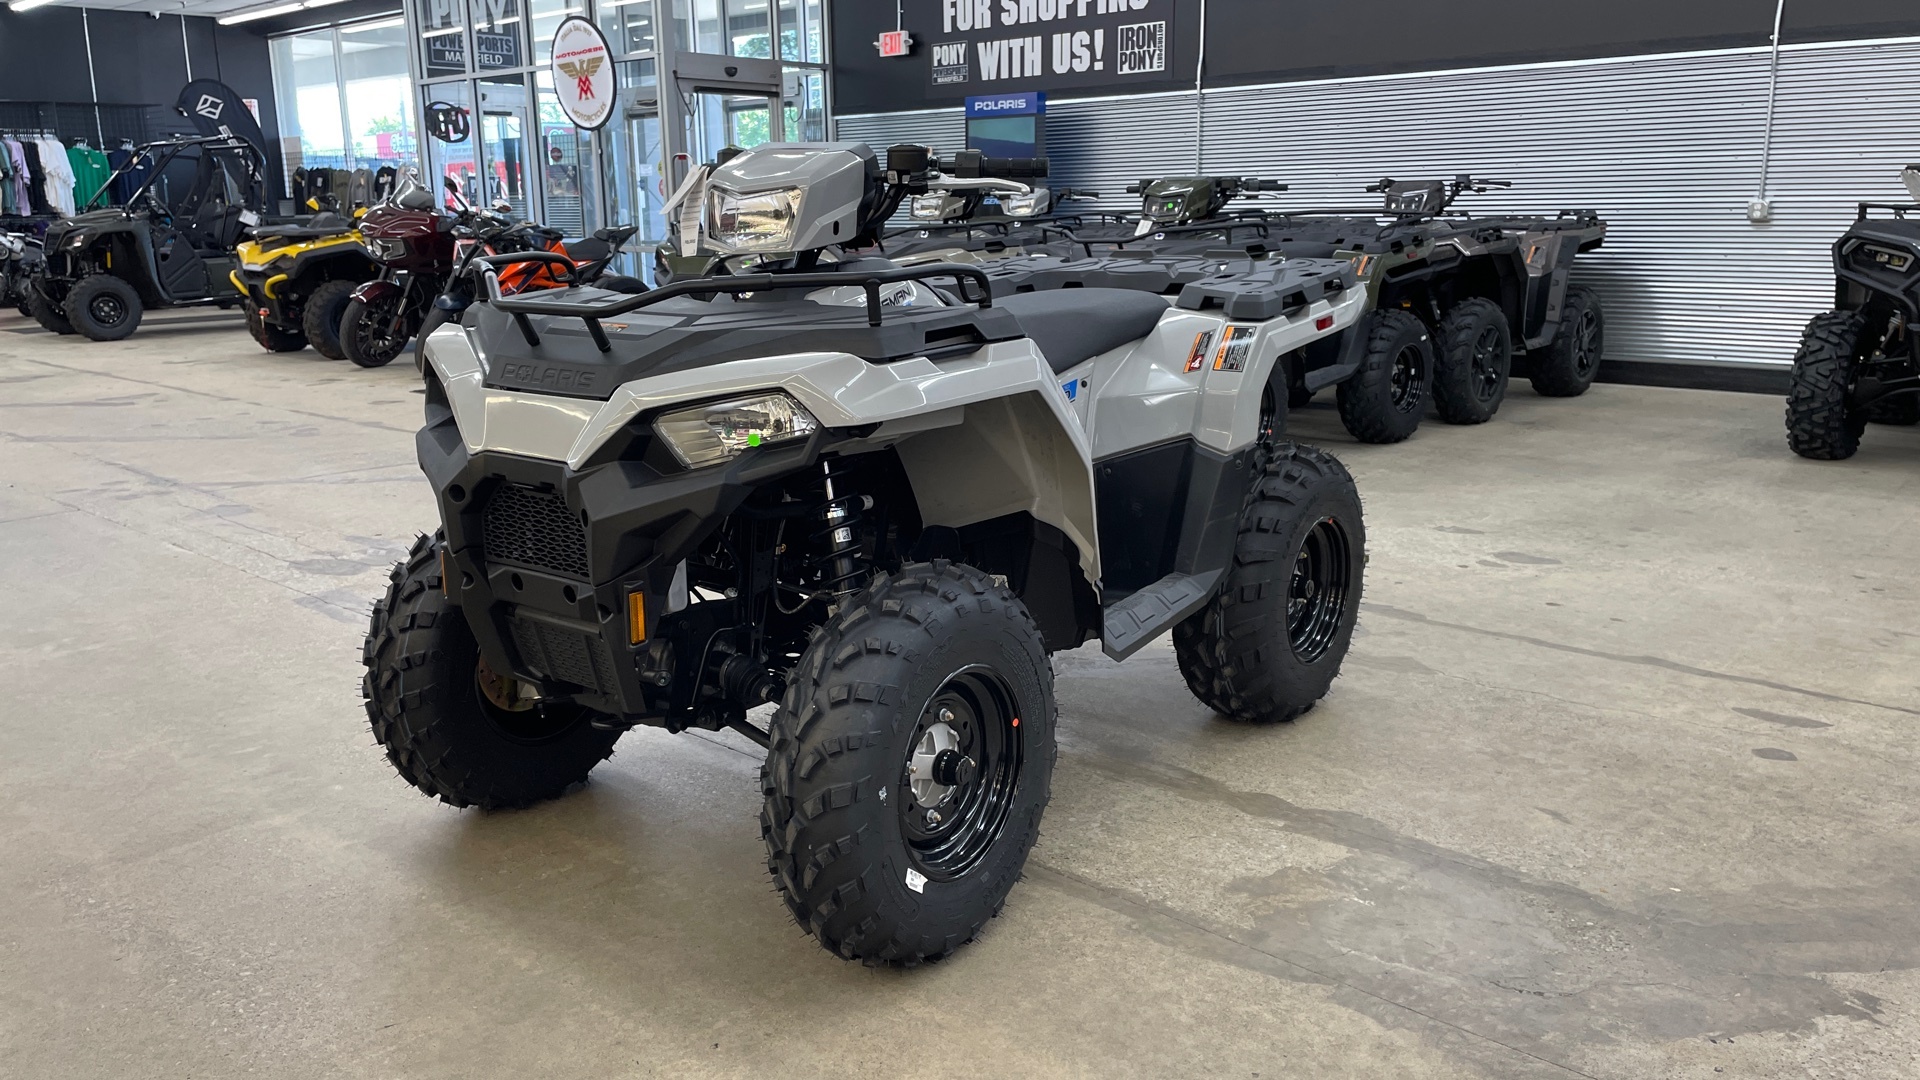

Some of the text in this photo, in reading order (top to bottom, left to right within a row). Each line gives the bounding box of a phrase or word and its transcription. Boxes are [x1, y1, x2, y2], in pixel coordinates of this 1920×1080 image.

[943, 0, 1149, 33] FOR SHOP
[432, 34, 513, 53] POWEPORTS
[883, 33, 902, 55] EXIT
[1120, 24, 1157, 51] IRON
[444, 51, 503, 65] MAFIELD
[933, 43, 966, 67] PONY
[977, 29, 1104, 81] WITH US!
[1119, 48, 1157, 72] PONY
[974, 98, 1027, 111] POLARIS
[500, 362, 597, 390] POLARIS
